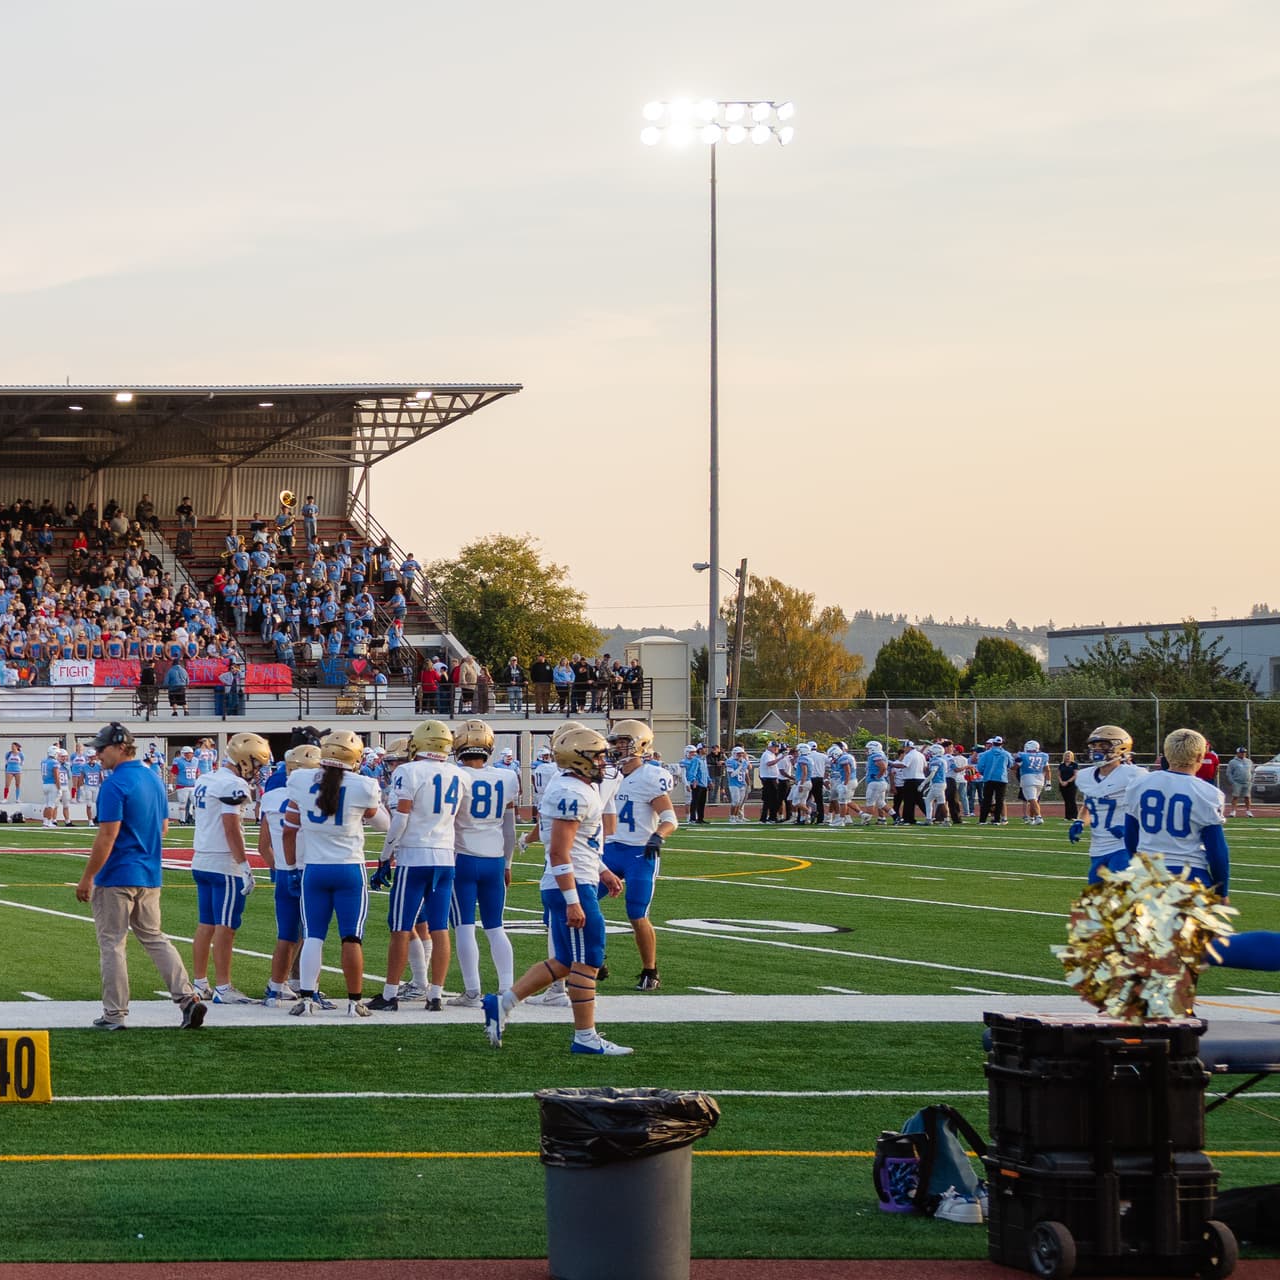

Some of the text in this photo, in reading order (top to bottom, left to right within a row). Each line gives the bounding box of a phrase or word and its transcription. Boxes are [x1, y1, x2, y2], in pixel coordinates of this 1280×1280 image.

[59, 665, 89, 678] FIGHT
[432, 773, 459, 816] 14
[469, 780, 504, 819] 81
[557, 798, 579, 816] 44
[1140, 789, 1193, 839] 80
